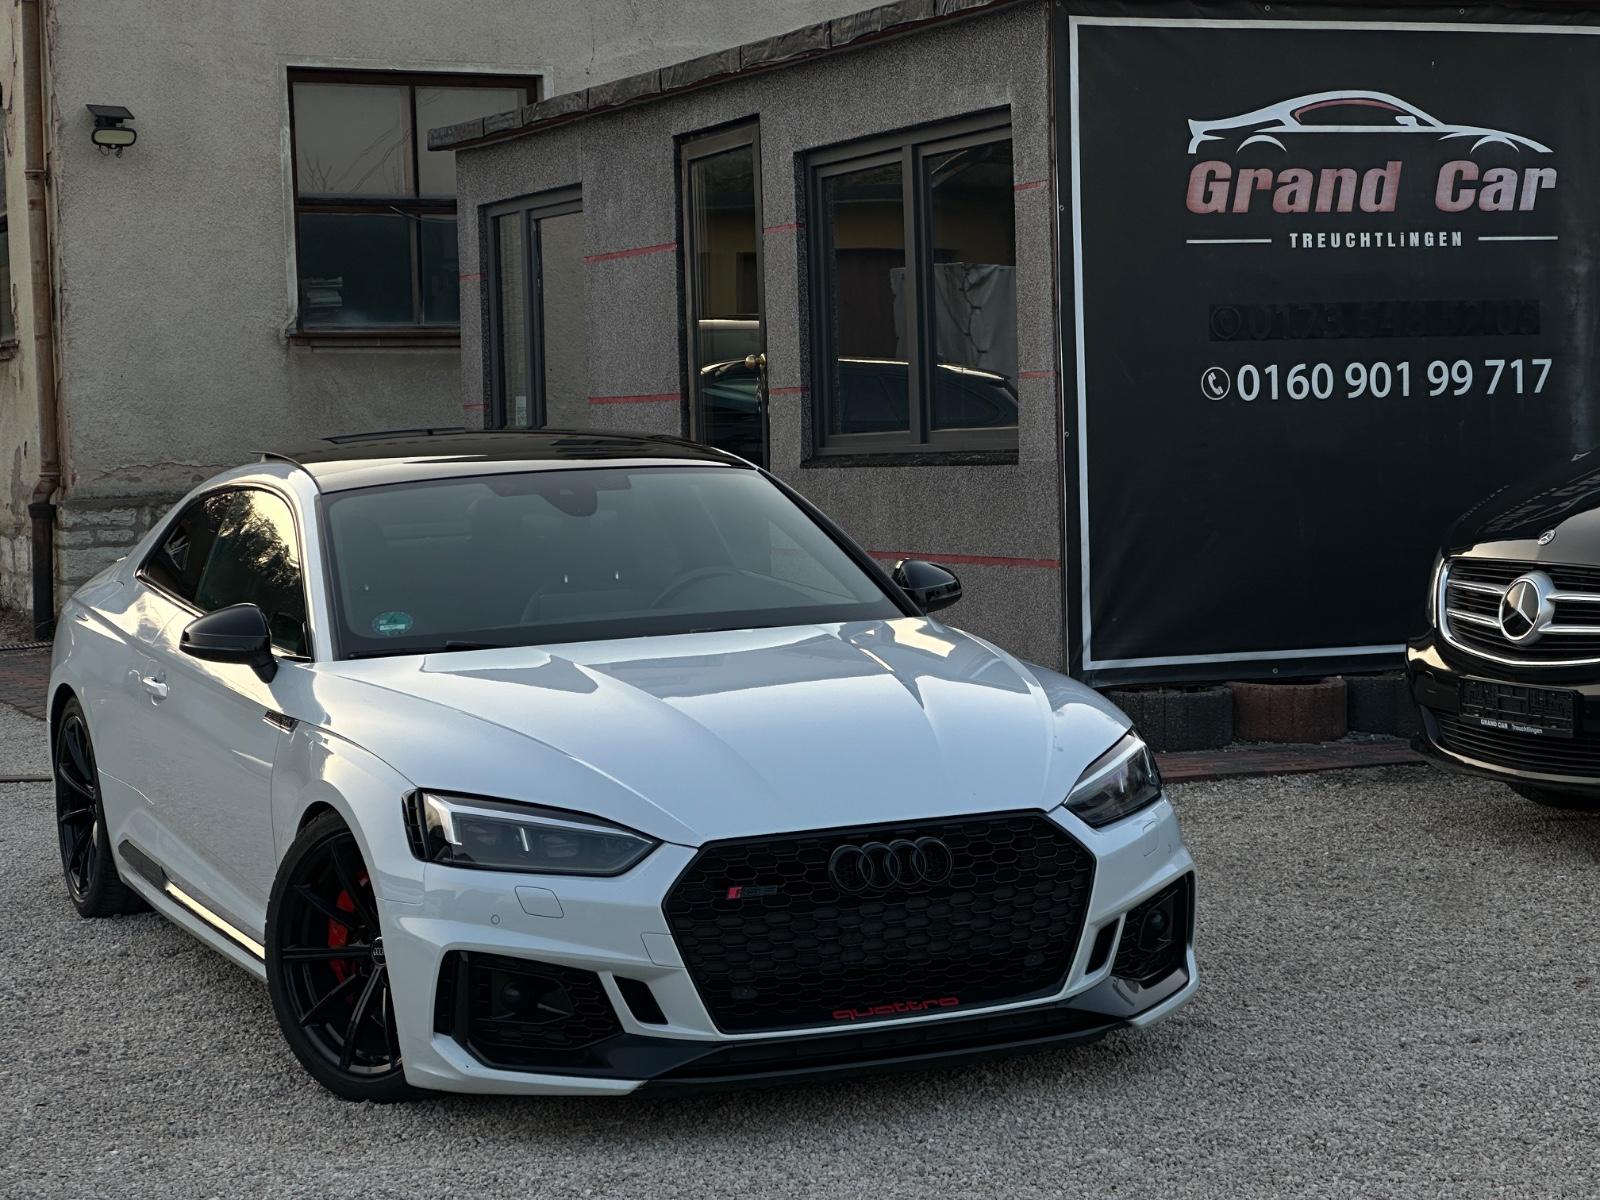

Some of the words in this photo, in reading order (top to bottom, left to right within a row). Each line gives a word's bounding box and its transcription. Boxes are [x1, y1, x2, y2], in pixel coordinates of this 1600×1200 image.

[1186, 160, 1402, 214] Grand
[1435, 160, 1557, 212] Car
[1236, 362, 1334, 402] 0160
[1344, 361, 1410, 399] 901
[1426, 359, 1473, 397] 99
[1484, 358, 1553, 395] 717
[1480, 719, 1498, 727] GRAND
[1498, 721, 1508, 729] CAR
[831, 996, 960, 1019] quattro
